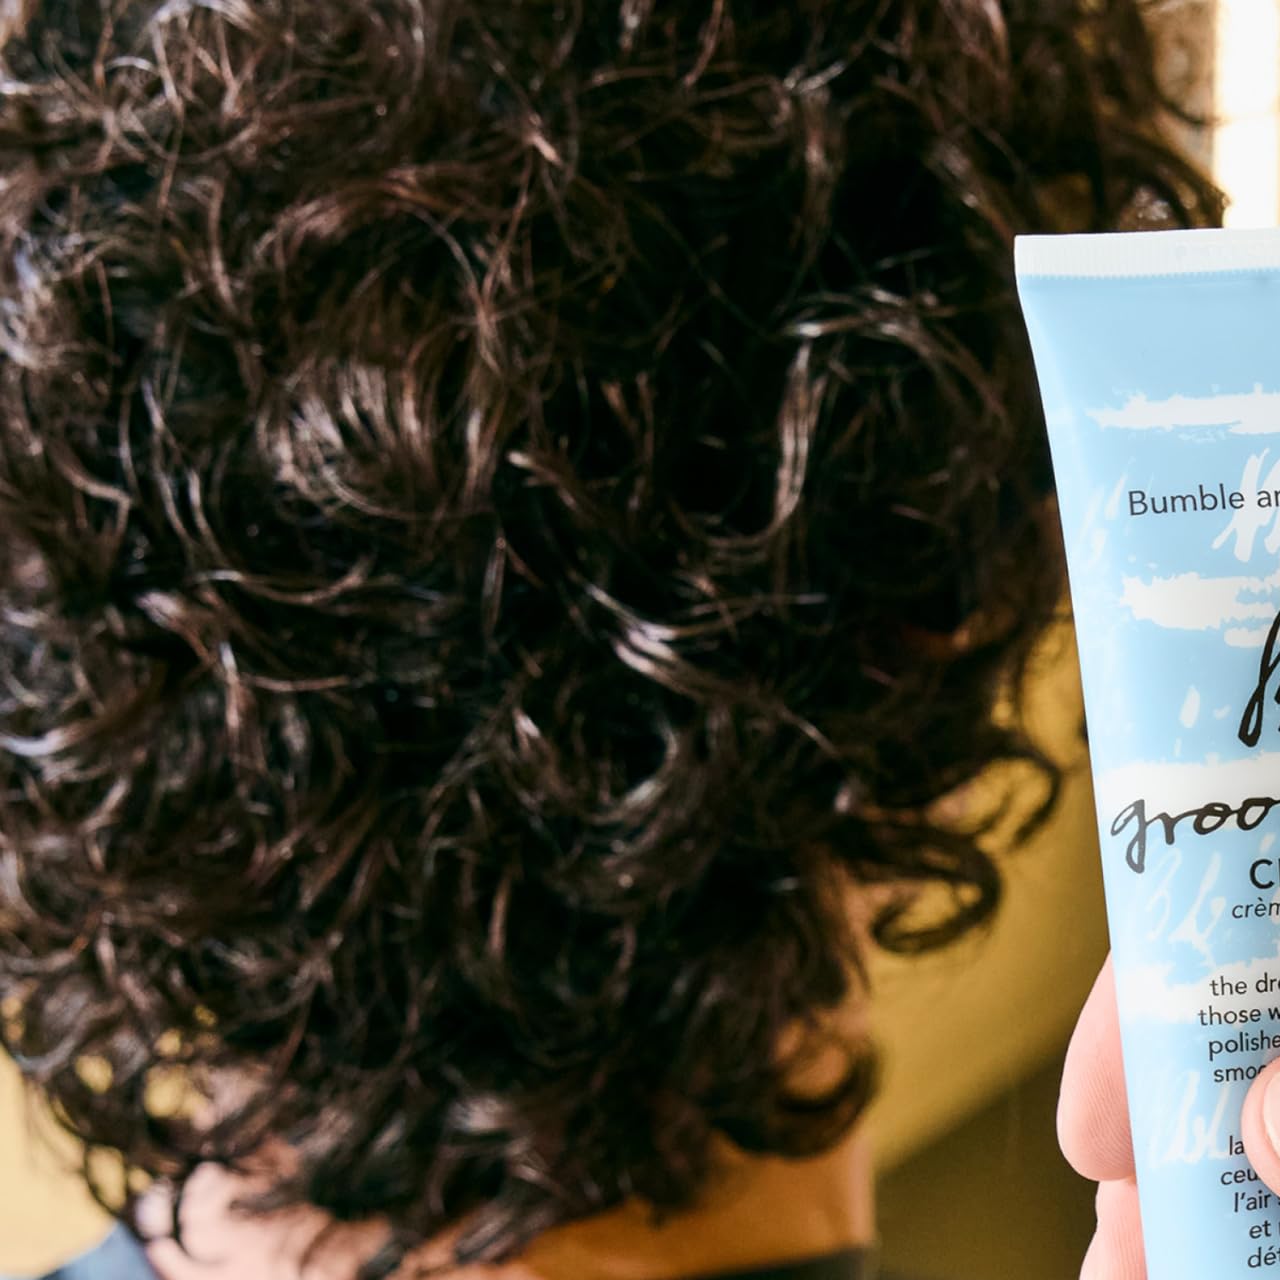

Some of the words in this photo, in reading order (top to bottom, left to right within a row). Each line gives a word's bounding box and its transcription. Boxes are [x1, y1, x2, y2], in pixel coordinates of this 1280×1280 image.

[1128, 484, 1244, 516] Bumble
[1209, 976, 1247, 996] the
[1198, 1005, 1261, 1026] those
[1220, 1168, 1258, 1185] ceu
[1249, 1220, 1272, 1239] et
